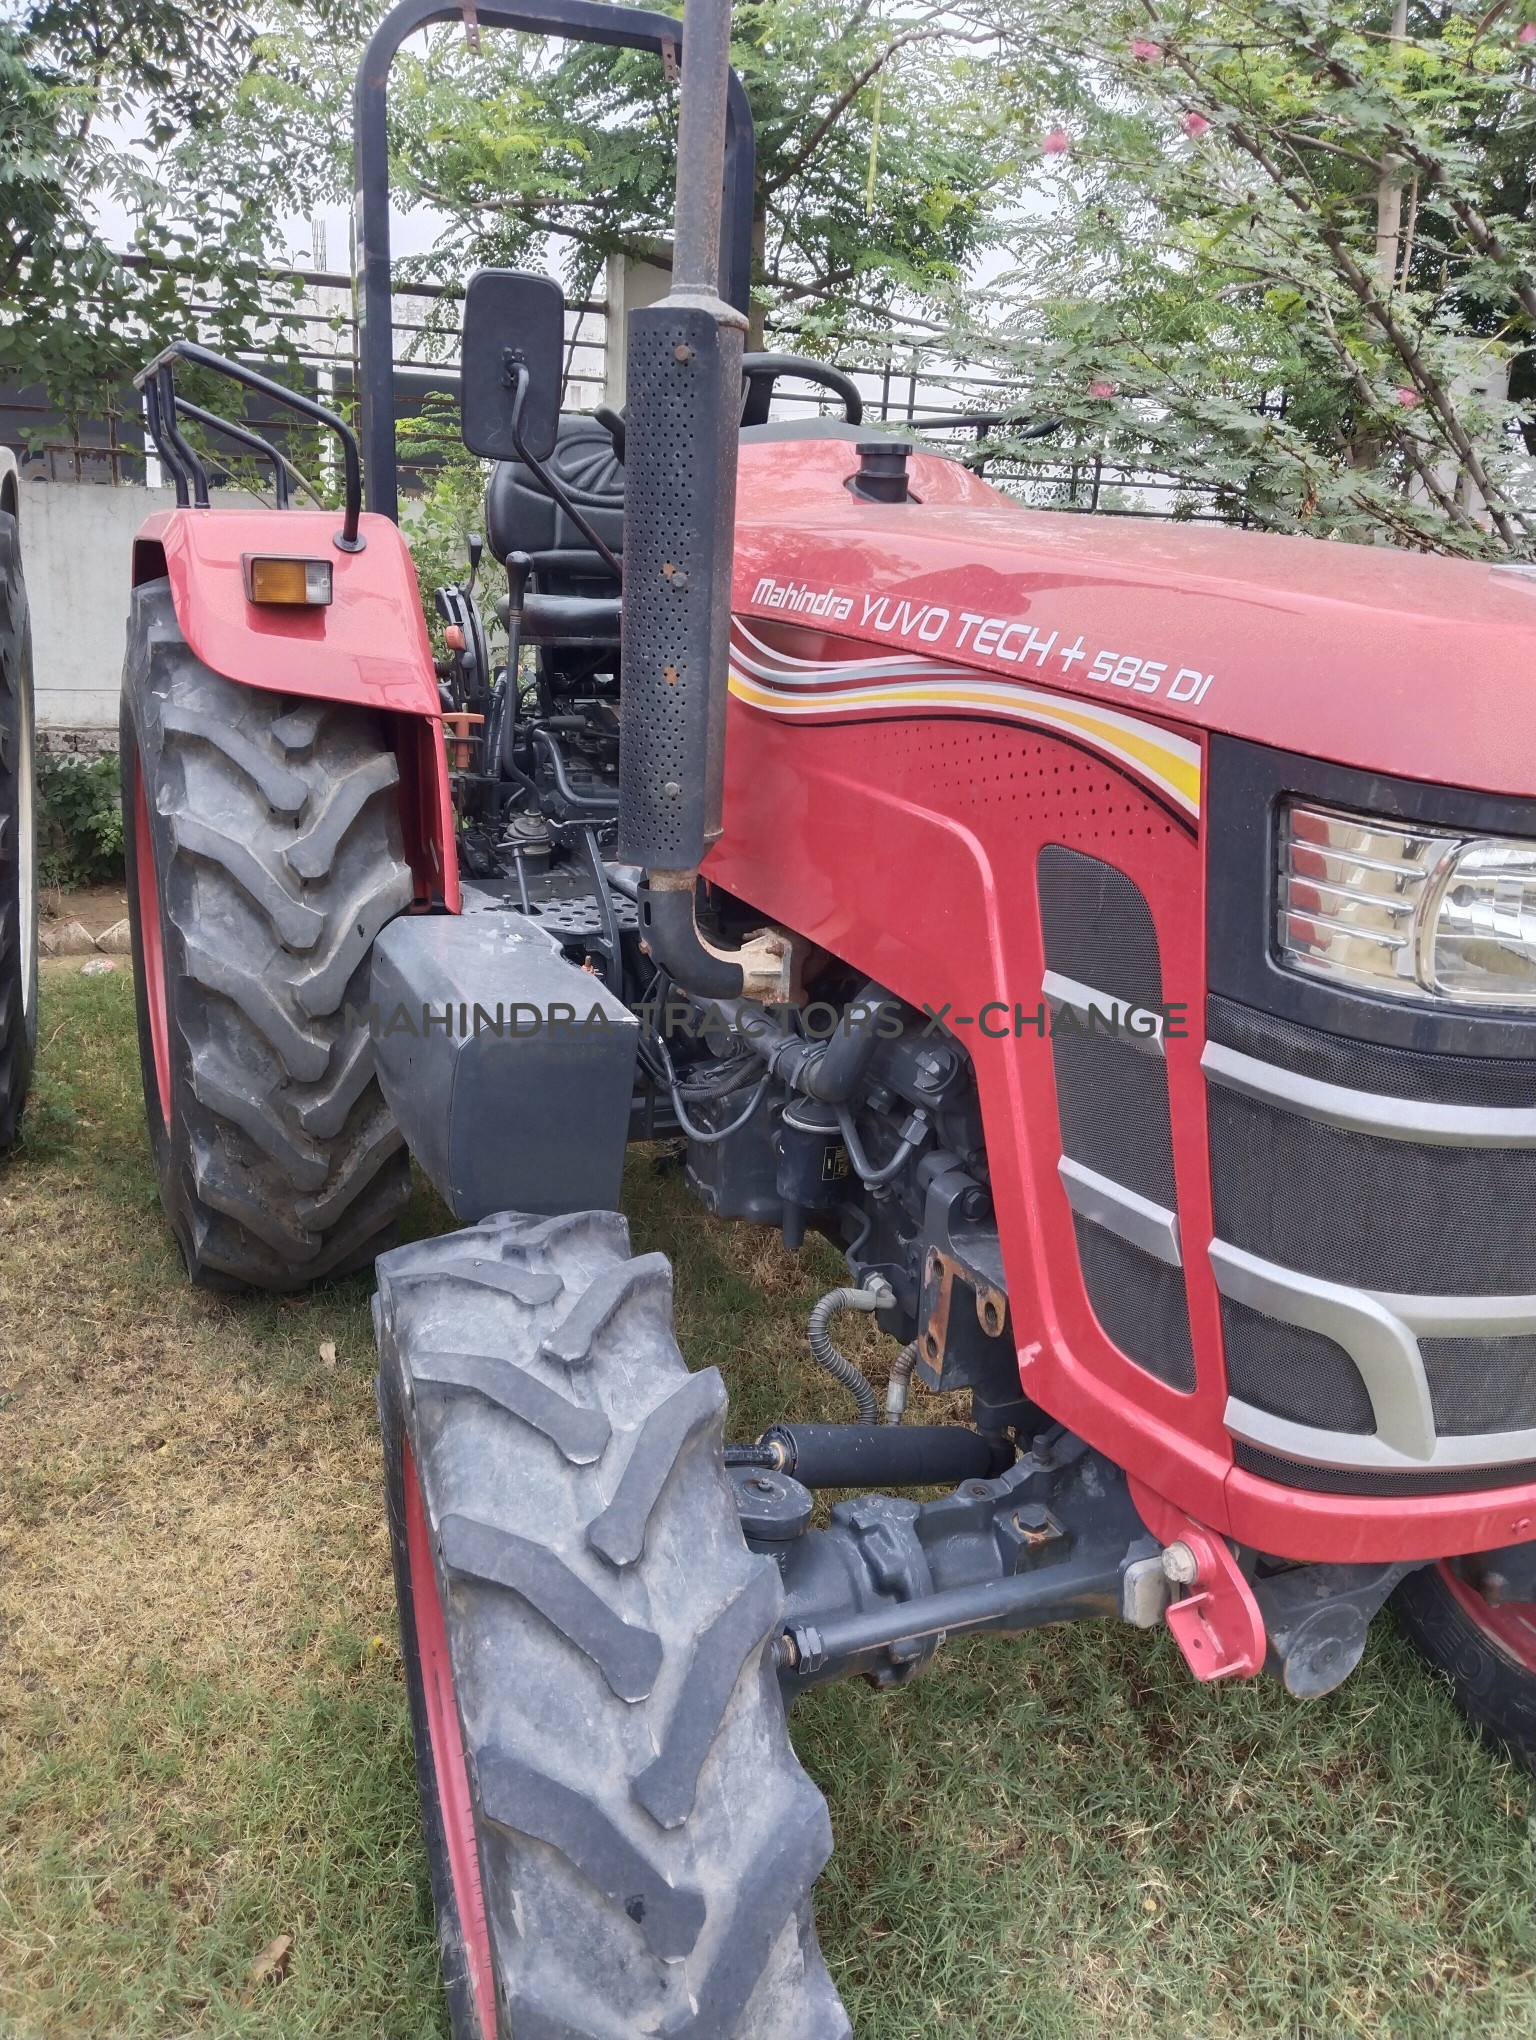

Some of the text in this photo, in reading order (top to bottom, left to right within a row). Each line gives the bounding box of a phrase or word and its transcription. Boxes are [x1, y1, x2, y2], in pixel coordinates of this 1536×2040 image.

[750, 577, 855, 621] Mahindra
[859, 593, 951, 643] YUVO
[1086, 650, 1169, 694] 585
[1165, 668, 1216, 706] DI
